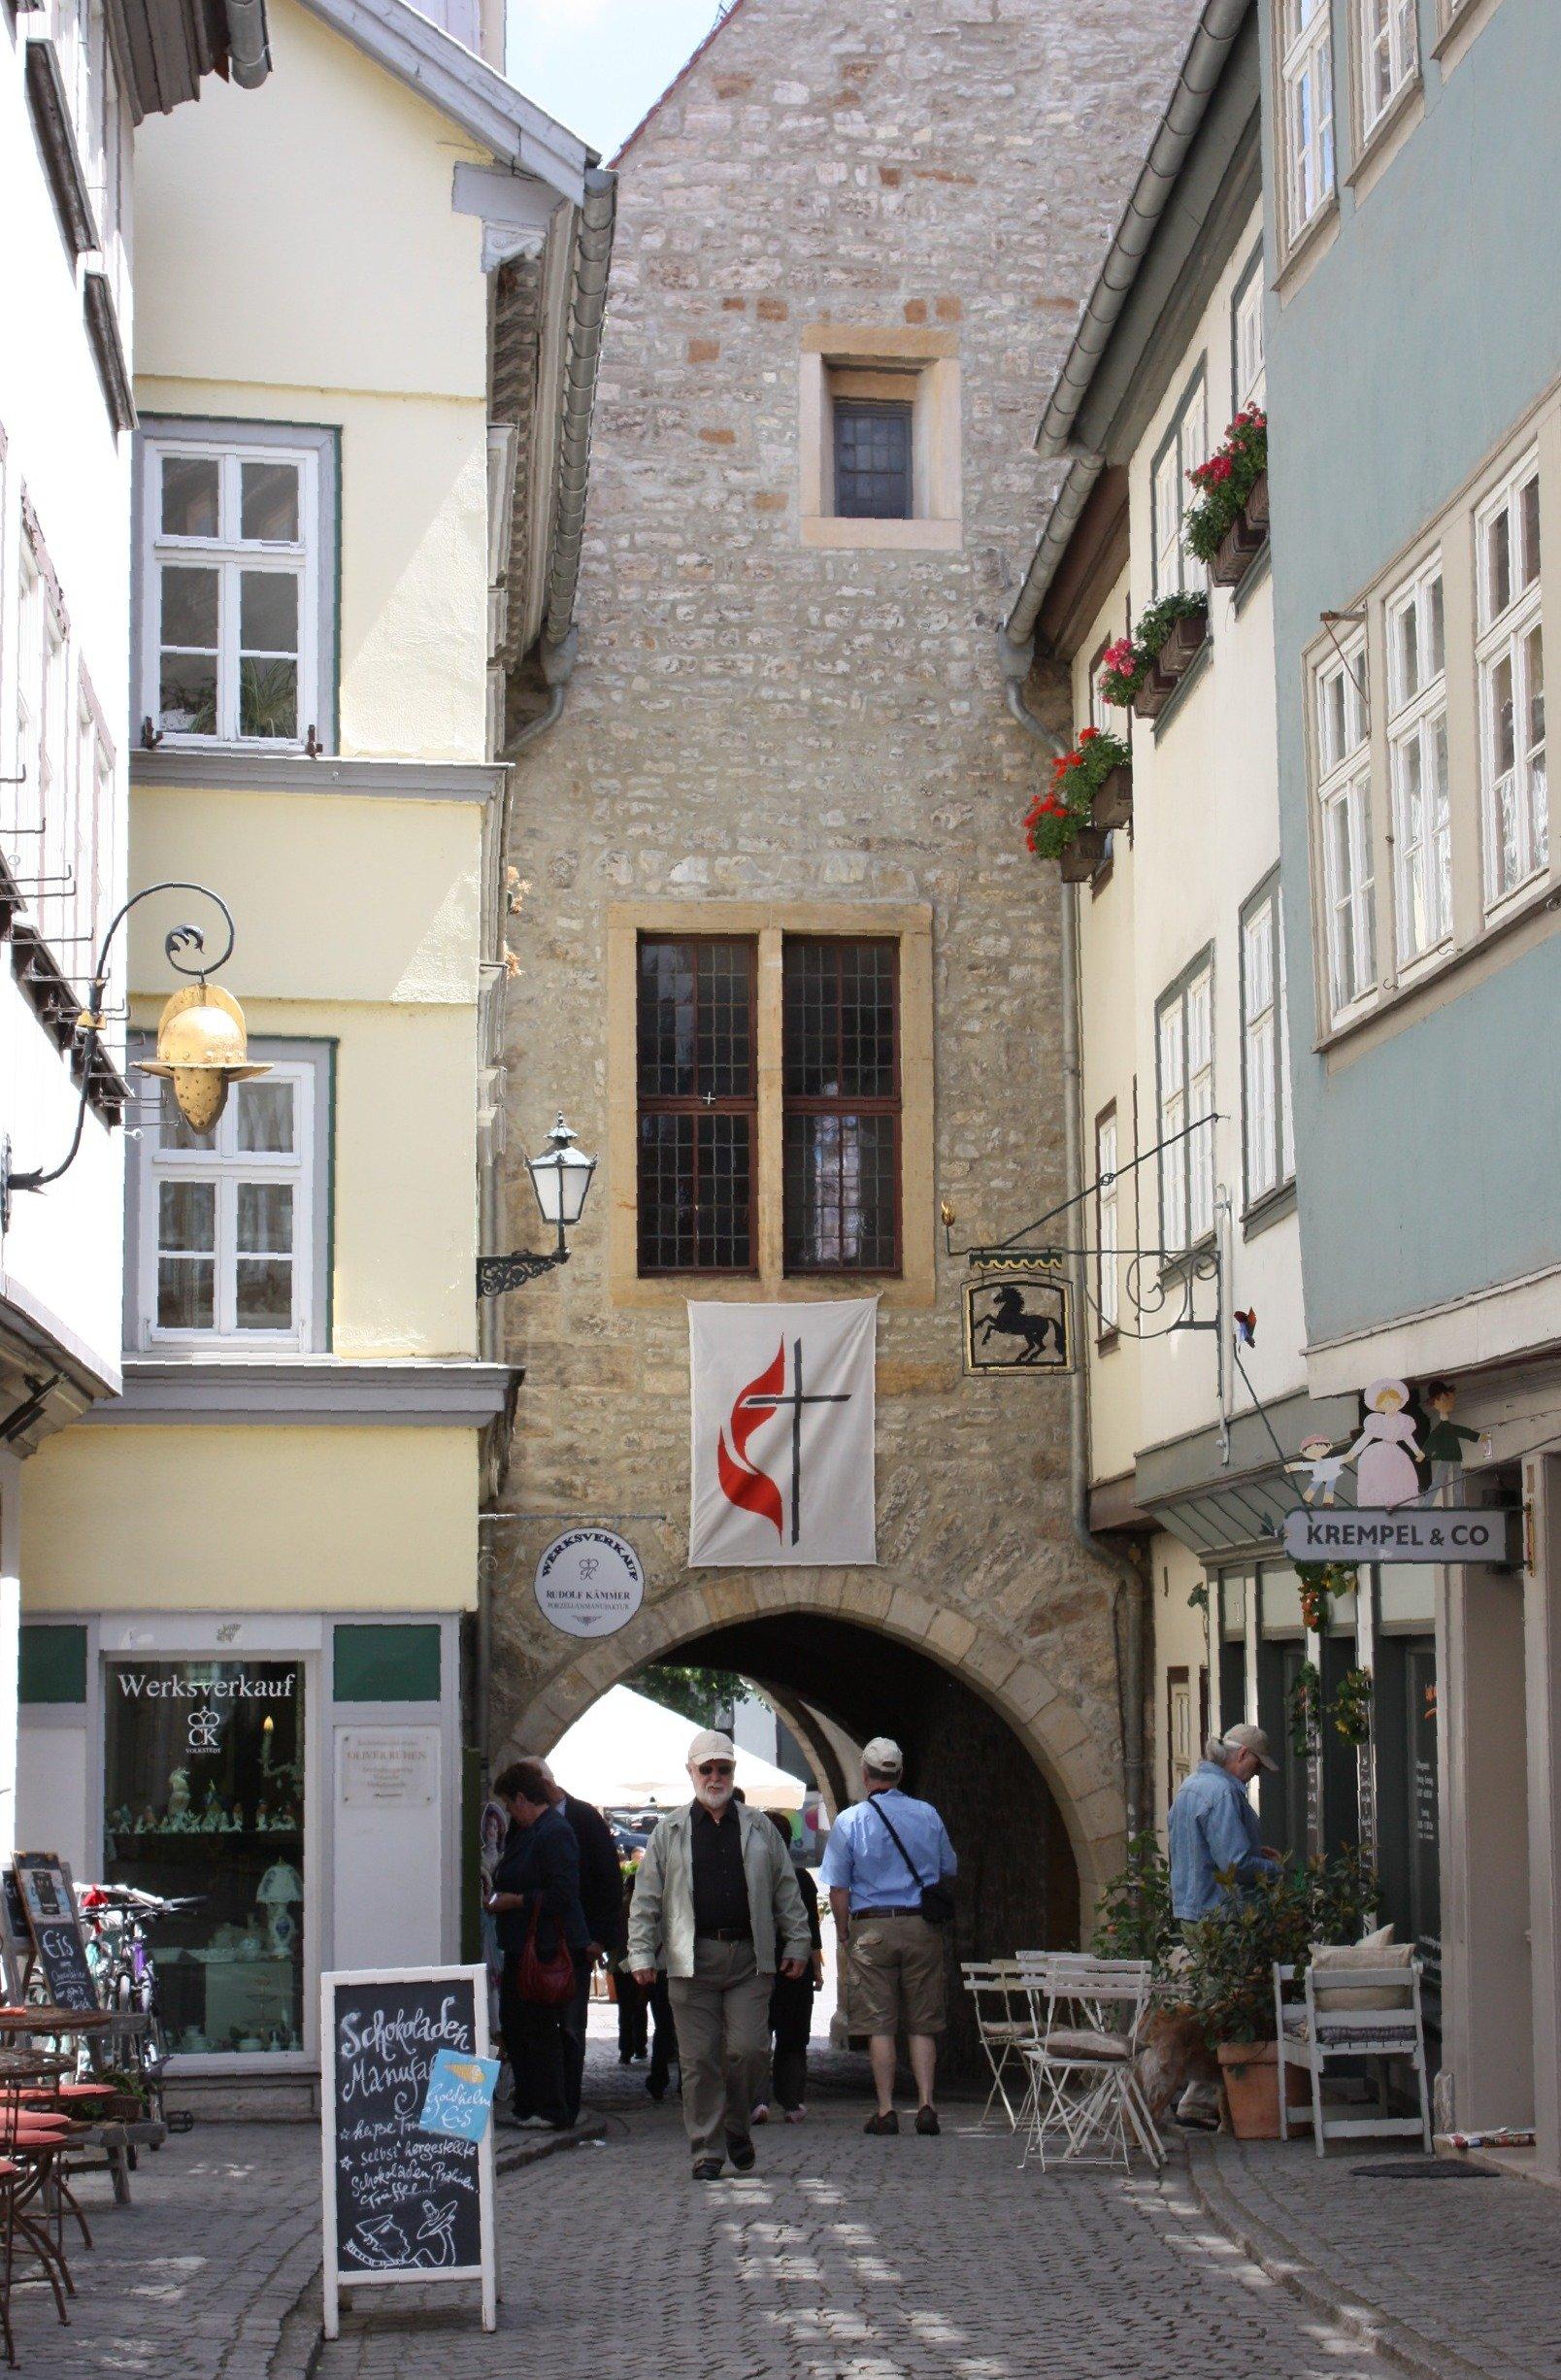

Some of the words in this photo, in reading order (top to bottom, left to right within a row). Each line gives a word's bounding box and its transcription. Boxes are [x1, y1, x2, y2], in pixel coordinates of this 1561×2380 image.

[1307, 1524, 1424, 1546] KREMPEL
[1429, 1527, 1445, 1546] &
[1450, 1525, 1490, 1546] CO
[542, 1532, 639, 1582] WERKSVERKAUF
[546, 1590, 583, 1600] RUDOLF
[585, 1589, 631, 1600] KÄMMER
[116, 1673, 296, 1698] Werksverkauf
[187, 1727, 219, 1747] CK
[42, 1929, 75, 1960] Eis
[340, 1995, 471, 2062] Schokoladen
[342, 2053, 438, 2116] Manufa
[441, 2104, 474, 2129] Eis
